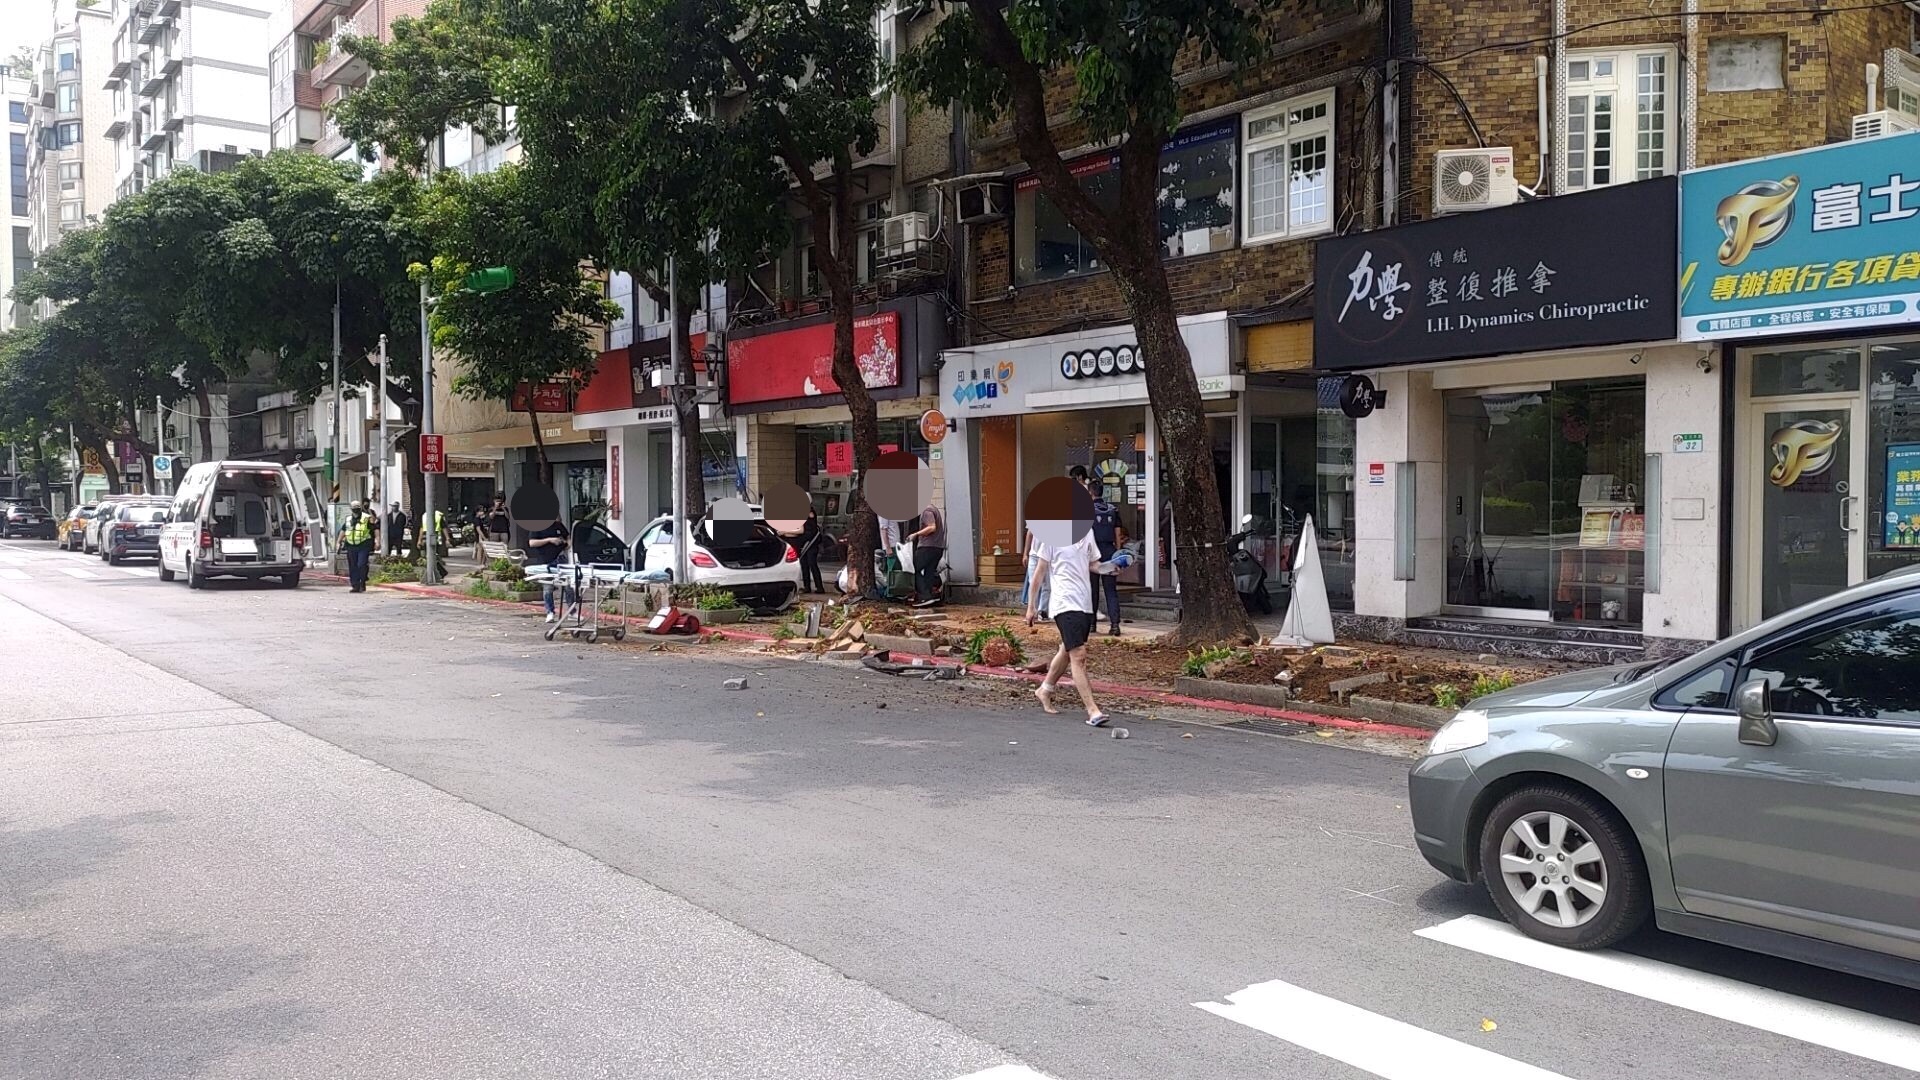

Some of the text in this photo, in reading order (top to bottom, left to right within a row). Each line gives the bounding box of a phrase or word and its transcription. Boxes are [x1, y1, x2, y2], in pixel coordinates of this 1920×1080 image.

[1428, 247, 1468, 268] 傳統
[1426, 260, 1557, 308] 整復推拿
[1458, 309, 1535, 333] Dynamics
[1538, 294, 1649, 324] Chiropractic
[1768, 309, 1814, 326] 全程保密
[1685, 441, 1697, 450] 32
